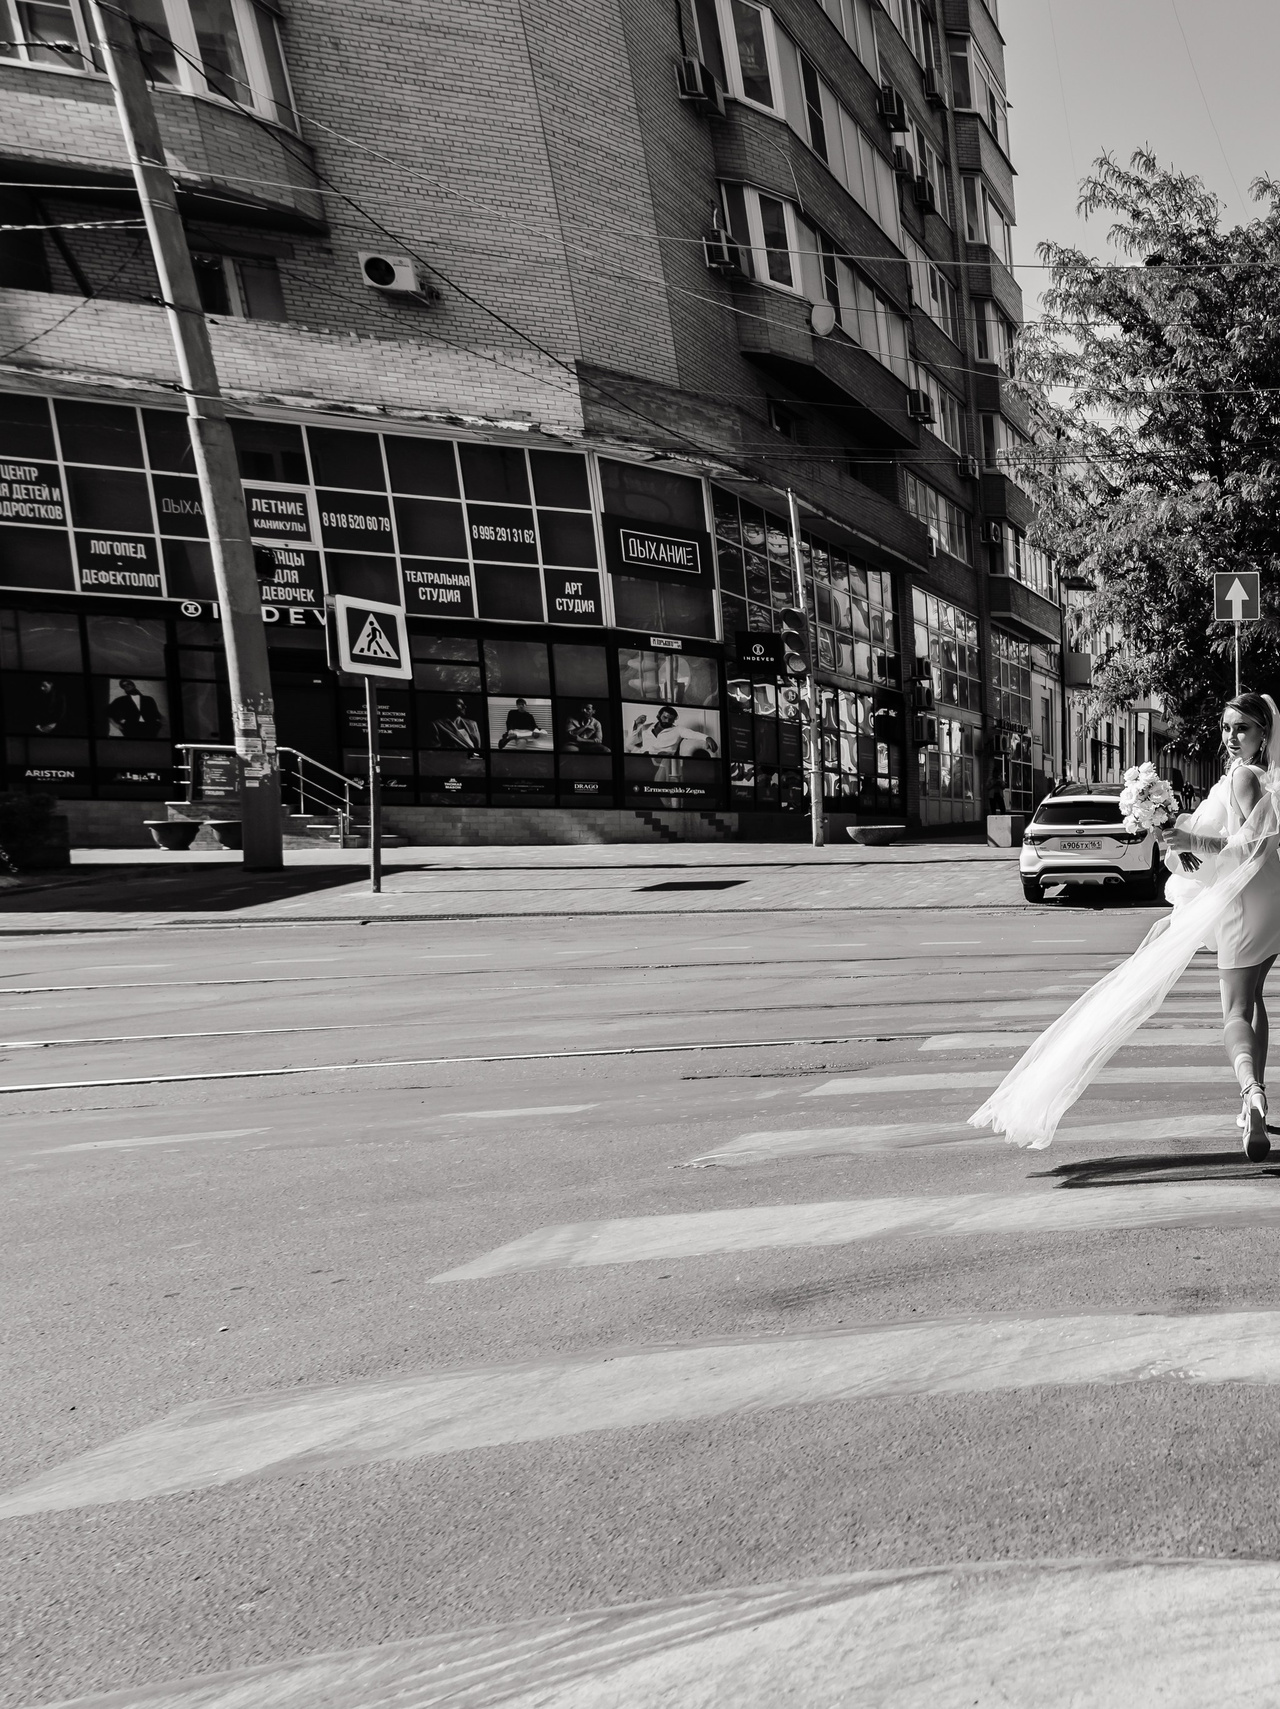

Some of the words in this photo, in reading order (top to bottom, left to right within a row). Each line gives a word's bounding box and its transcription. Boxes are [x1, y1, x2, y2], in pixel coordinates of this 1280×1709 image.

[0, 464, 38, 481] ЦЕНТР
[12, 483, 50, 501] ДЕТЕЙ
[51, 487, 61, 501] И
[162, 498, 204, 515] ДЫХА
[252, 498, 305, 516] ЛЕТНИЕ
[253, 518, 307, 532] КАНИКУЛЫ
[322, 512, 329, 527] 8
[330, 512, 348, 528] 918
[348, 514, 365, 530] 520
[366, 516, 378, 531] 60
[378, 517, 390, 532] 79
[472, 525, 479, 539] 8
[479, 525, 495, 541] 995
[496, 527, 511, 542] 291
[512, 528, 523, 543] 31
[524, 529, 535, 544] 62
[90, 540, 147, 559] ЛОГОПЕД
[629, 538, 694, 566] ДЫХАНИЕ
[82, 569, 160, 588] ДЕФЕКТОЛОГ
[274, 569, 299, 584] ДЛЯ
[404, 570, 471, 587] ТЕАТРАЛЬНАЯ
[262, 586, 316, 602] ДЕВОЧЕК
[418, 587, 461, 603] СТУДИЯ
[565, 581, 583, 596] АРТ
[555, 598, 595, 614] СТУДИЯ
[25, 769, 75, 778] ARISTON
